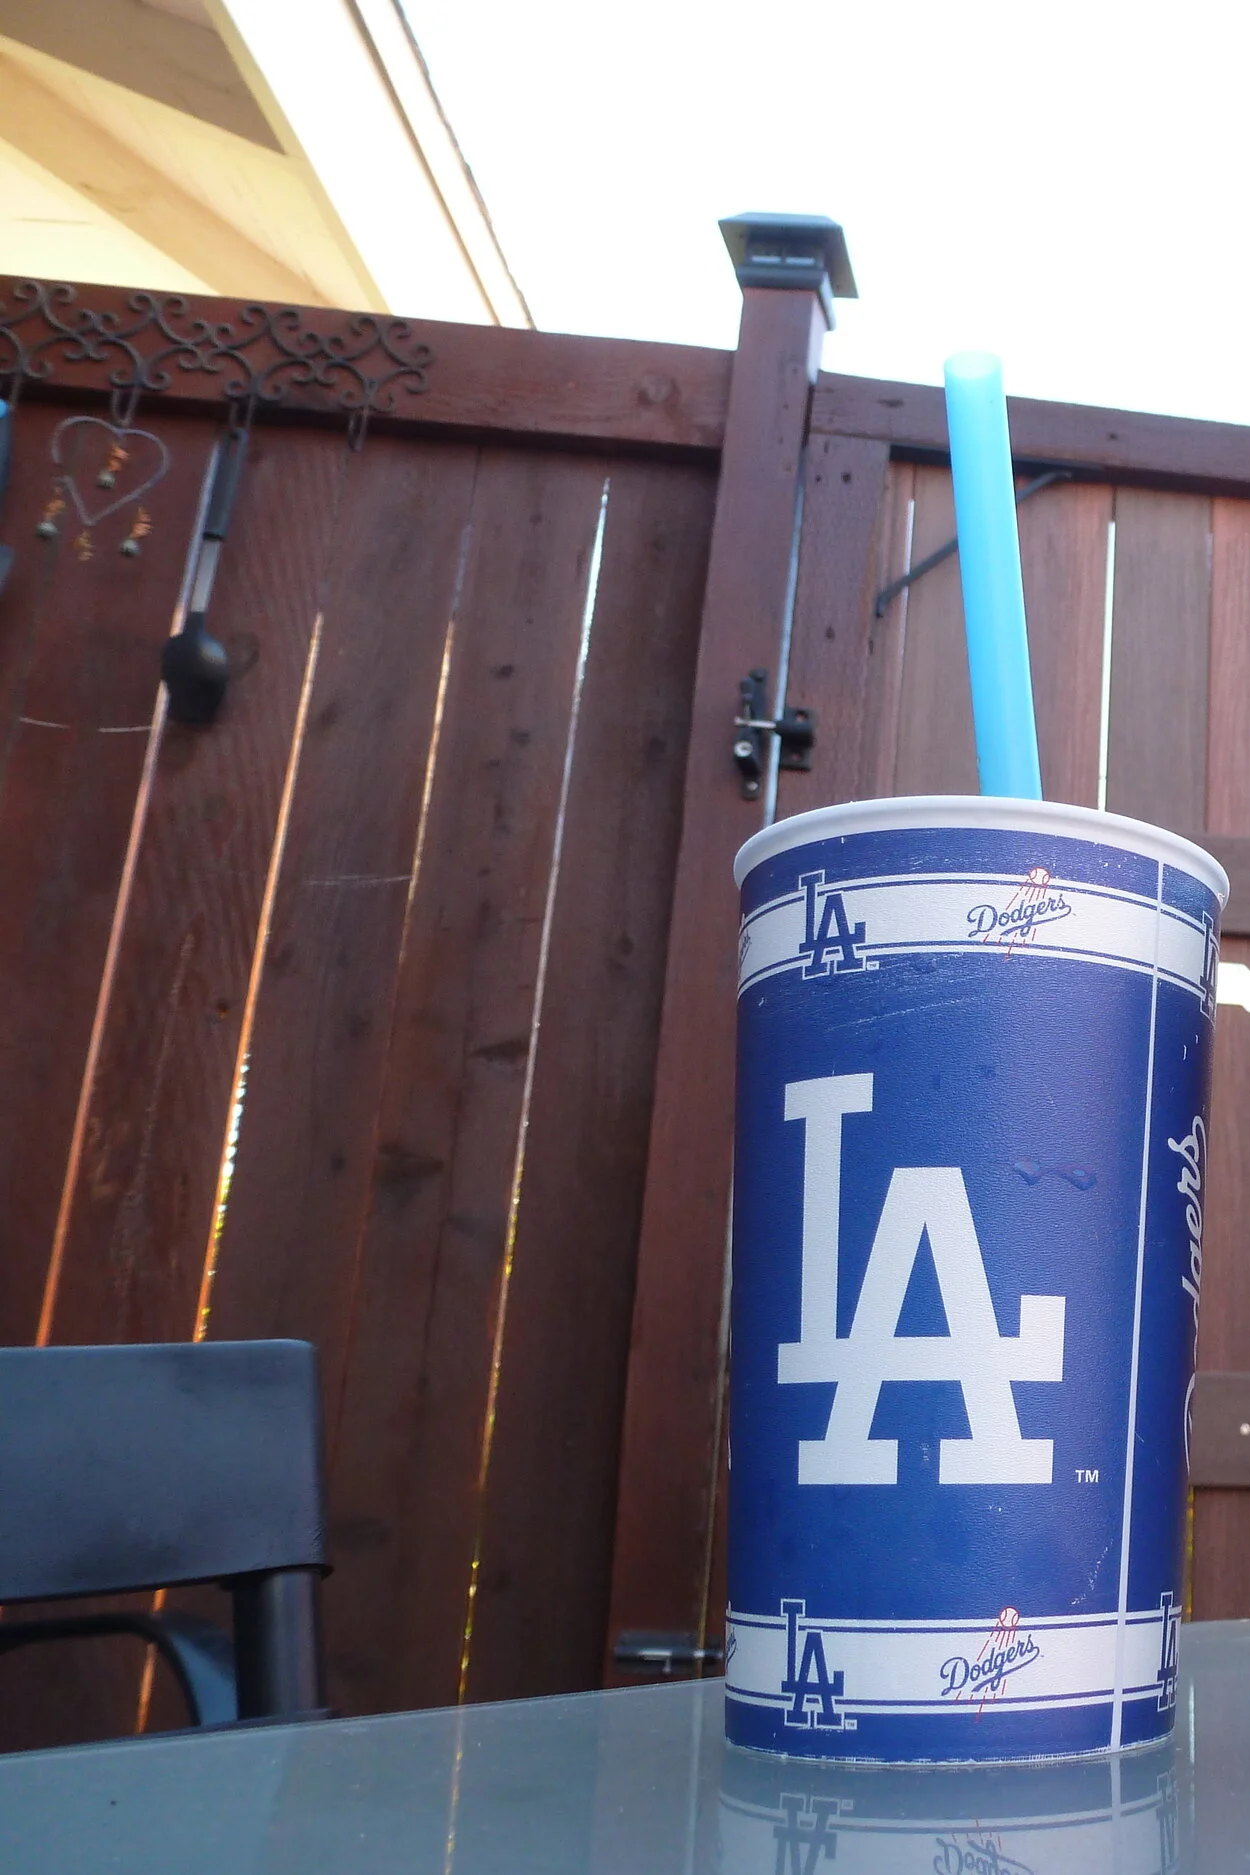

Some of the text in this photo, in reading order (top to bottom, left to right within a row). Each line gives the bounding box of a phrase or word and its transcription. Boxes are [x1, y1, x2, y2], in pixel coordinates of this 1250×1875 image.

[800, 870, 866, 980] LA
[967, 893, 1072, 937] Dodgers
[778, 1072, 1099, 1485] LA TM
[780, 1598, 846, 1730] LA
[940, 1633, 1040, 1696] Dodgers
